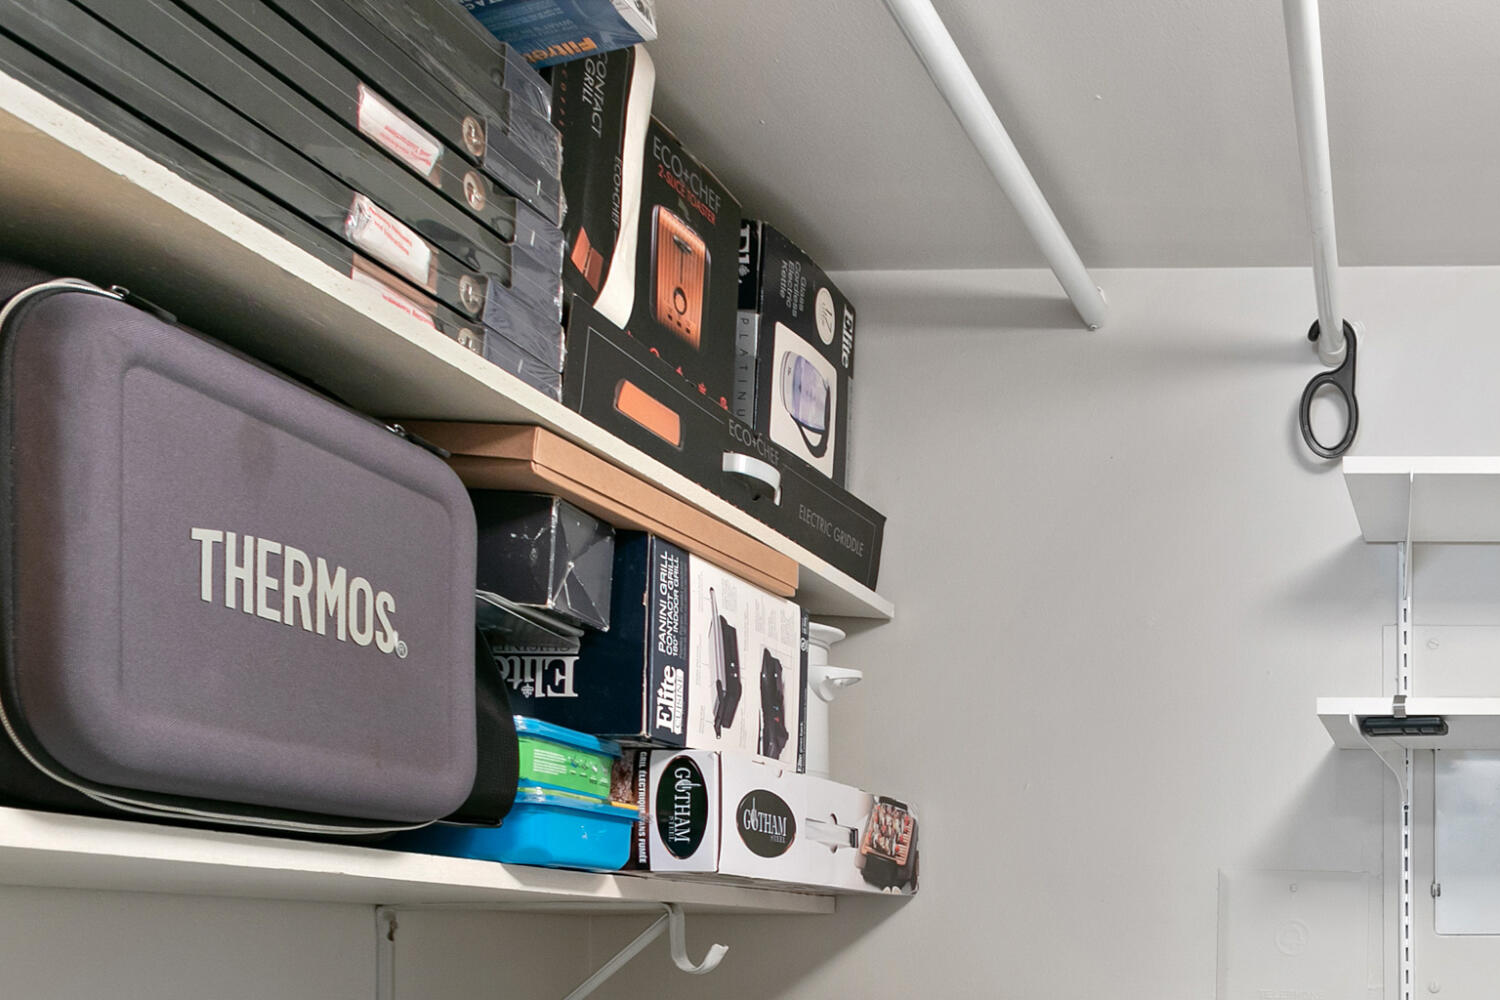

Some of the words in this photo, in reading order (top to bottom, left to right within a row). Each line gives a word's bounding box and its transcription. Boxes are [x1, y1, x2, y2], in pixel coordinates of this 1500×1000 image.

[582, 58, 596, 106] GRILL
[652, 135, 721, 214] ECO+CHEF
[687, 189, 716, 226] TOASTER
[841, 303, 854, 369] Elite
[737, 317, 749, 417] PLATINU
[728, 418, 781, 467] ECO+CHEF
[799, 504, 833, 537] ELECTRIC
[833, 526, 864, 558] GRIDDLE
[190, 526, 396, 654] THERMOS
[660, 550, 668, 596] GRILL
[658, 599, 667, 653] PANINI
[665, 593, 674, 656] CONTACT
[656, 665, 676, 734] Elite
[638, 817, 647, 837] ANS
[674, 766, 692, 843] GOTHAM
[743, 806, 787, 837] GOTHAM
